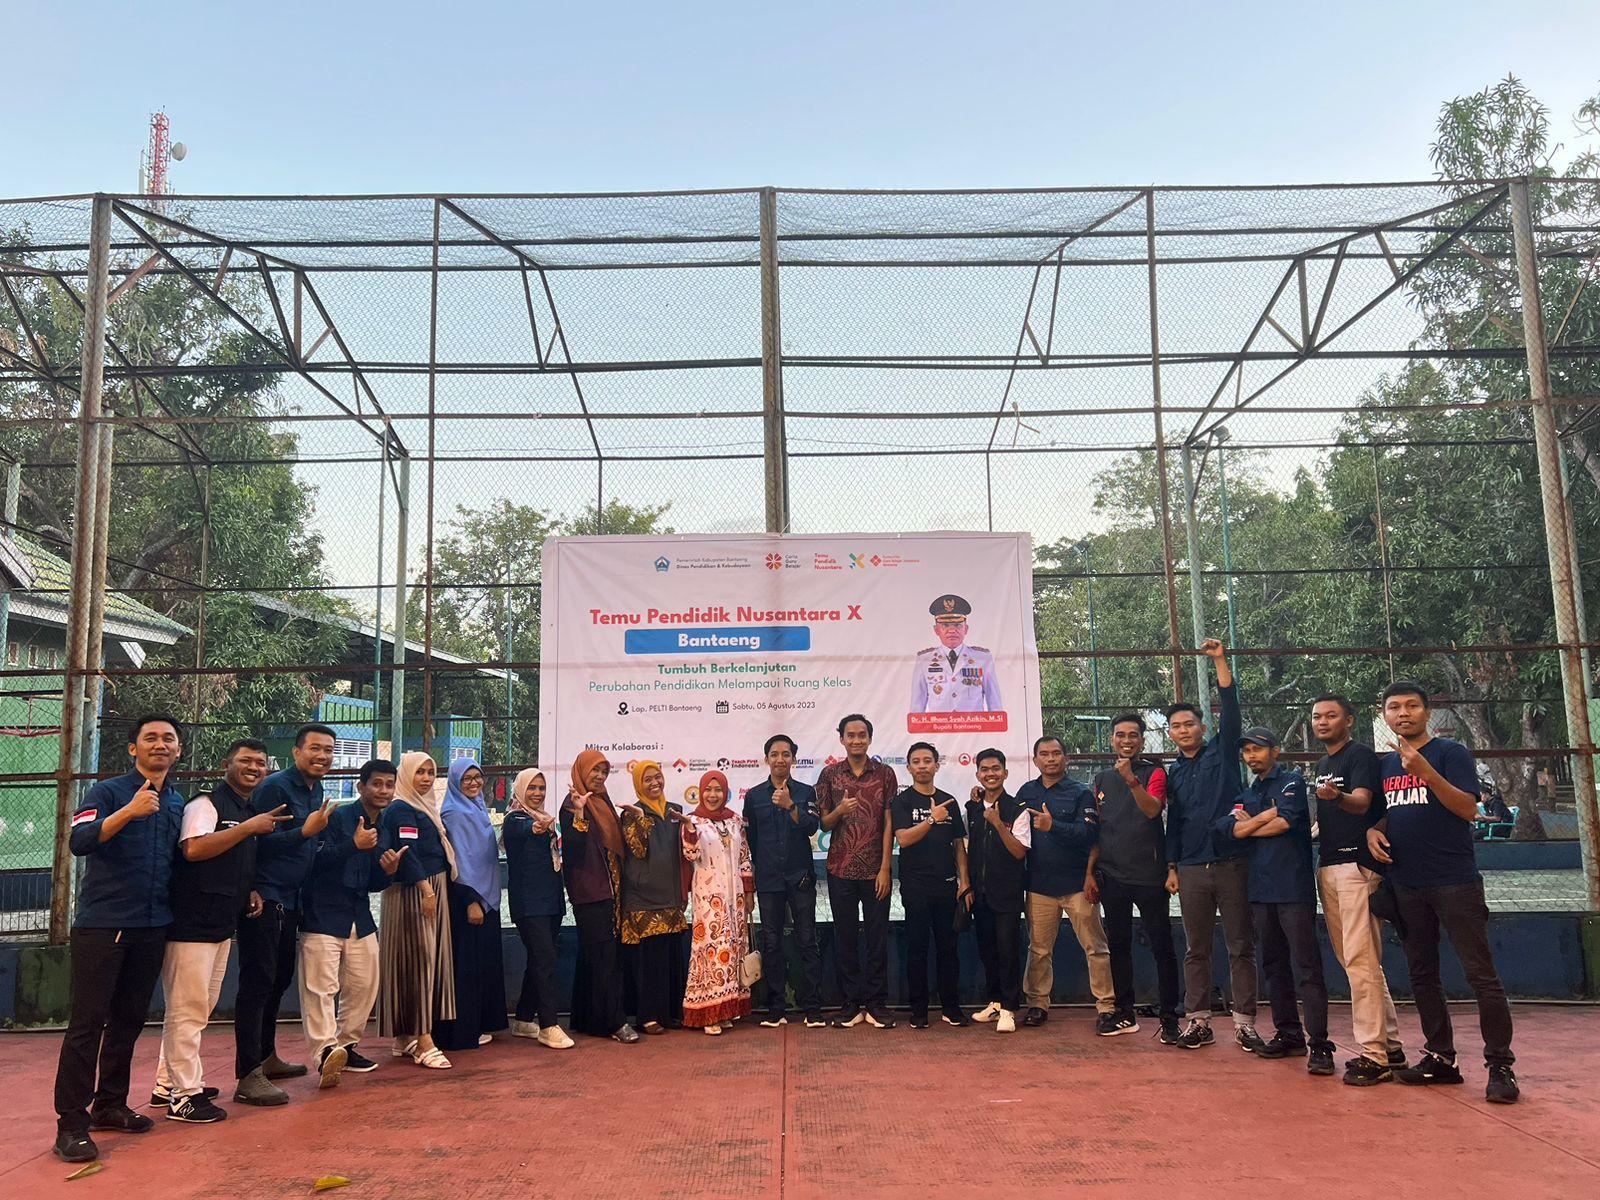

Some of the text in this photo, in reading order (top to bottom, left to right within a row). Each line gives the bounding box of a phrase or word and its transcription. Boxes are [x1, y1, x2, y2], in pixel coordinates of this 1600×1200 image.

[590, 605, 862, 624] Temu Pendidik Nusantara X
[678, 634, 761, 649] Bantaeng
[658, 663, 796, 675] Tumbuh Berkelanjutan
[589, 677, 852, 692] Perubahan Pendidikan Melampaui Ruang Kelas
[632, 706, 647, 714] Lap.
[669, 705, 702, 713] Bantaeng
[768, 702, 795, 710] Agustus
[612, 742, 658, 751] Kolaborasi
